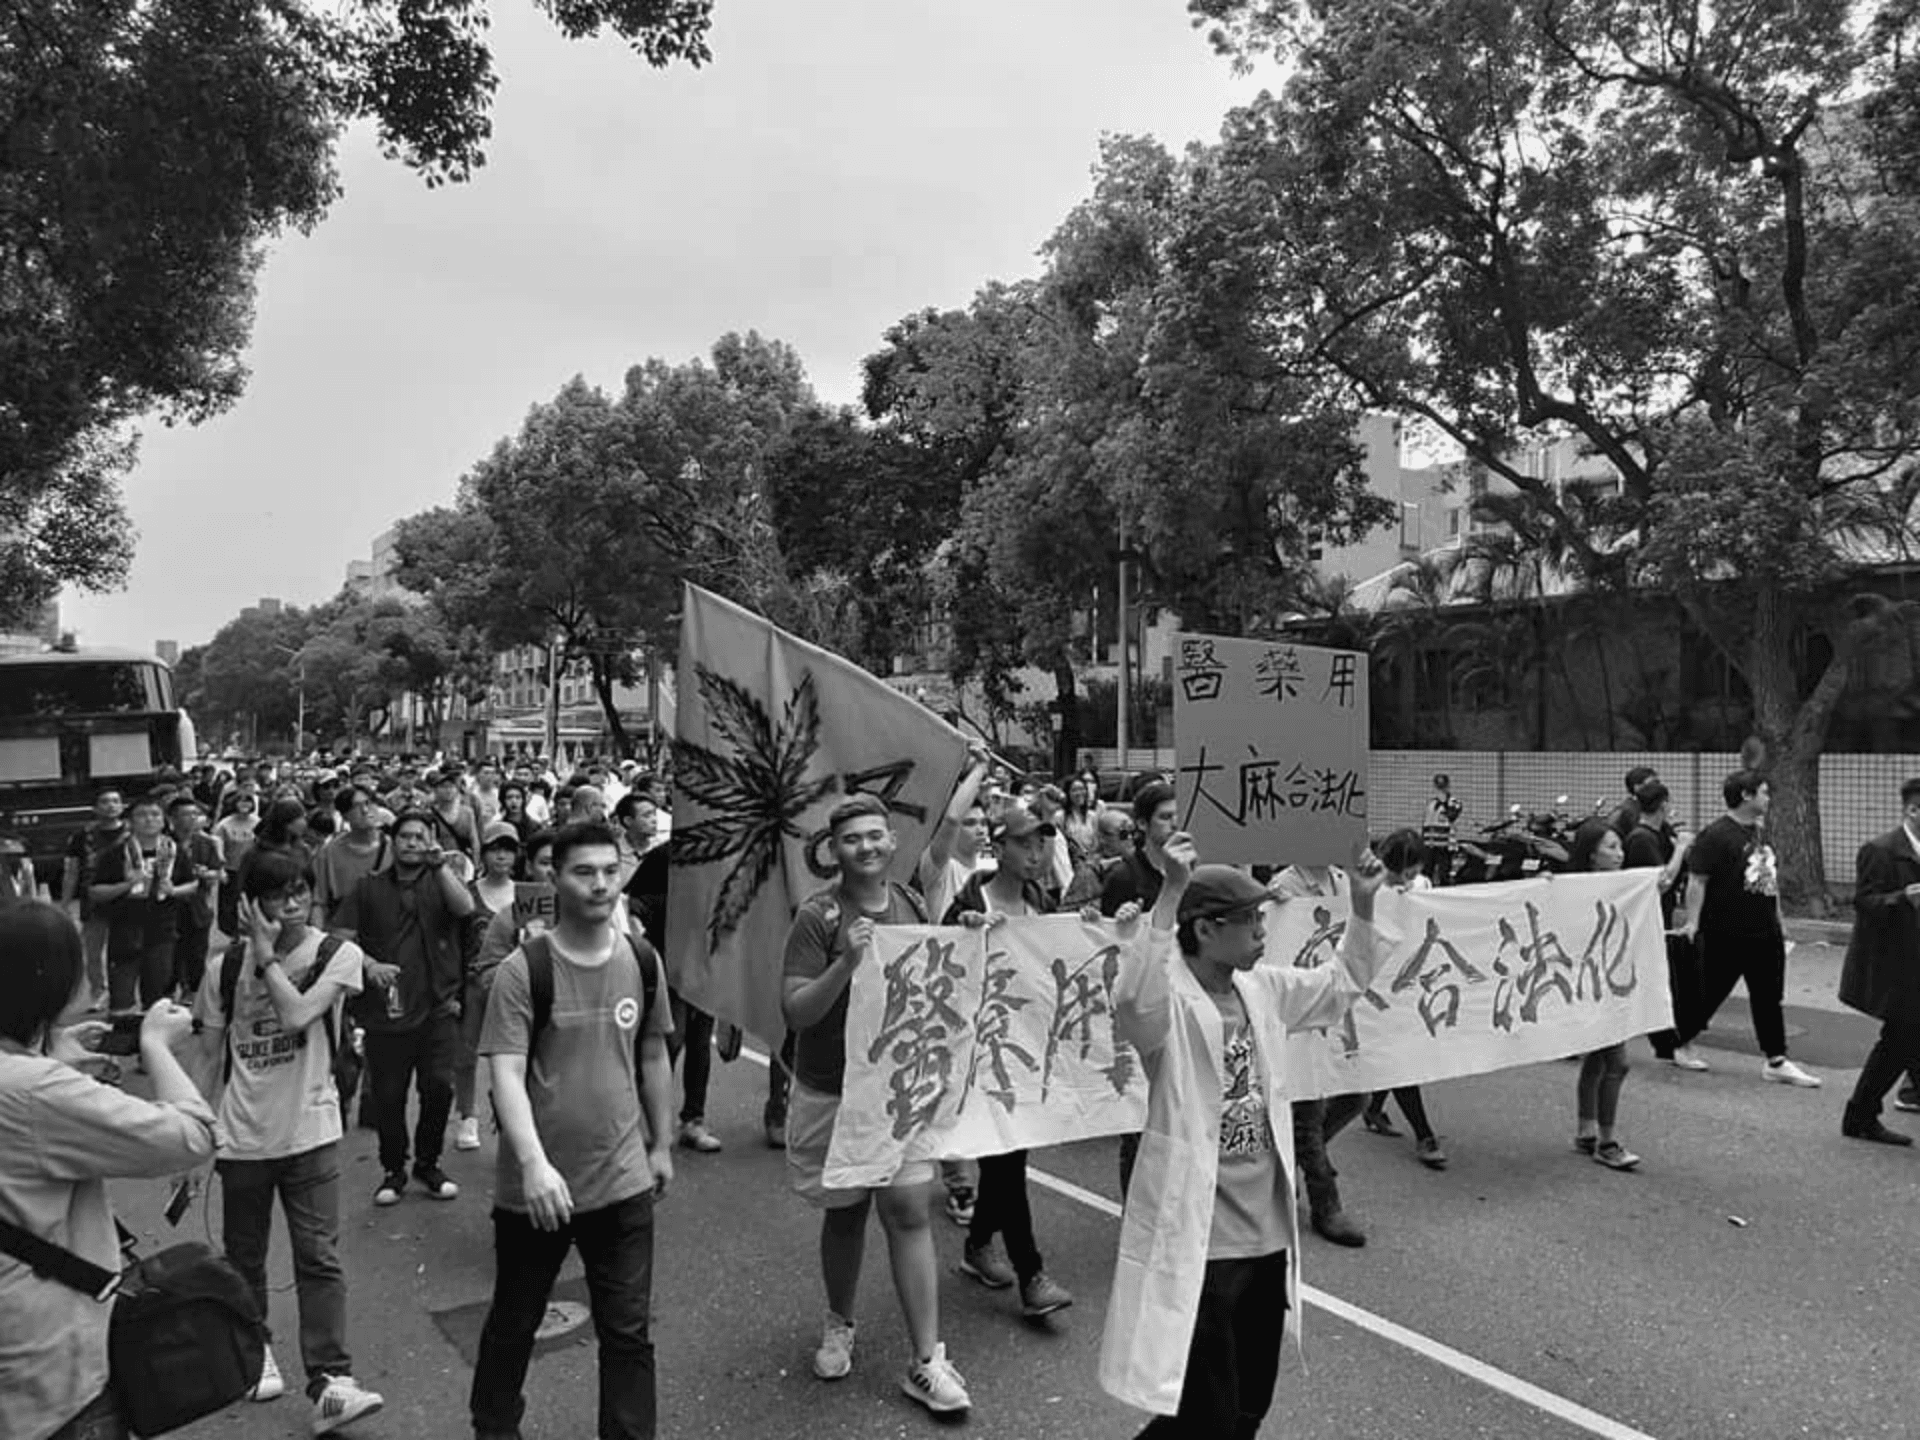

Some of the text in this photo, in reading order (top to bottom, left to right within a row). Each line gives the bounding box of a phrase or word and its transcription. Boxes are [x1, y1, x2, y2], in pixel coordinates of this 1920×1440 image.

[1176, 639, 1357, 708] 醫藥用
[1180, 744, 1366, 831] 大麻合法化
